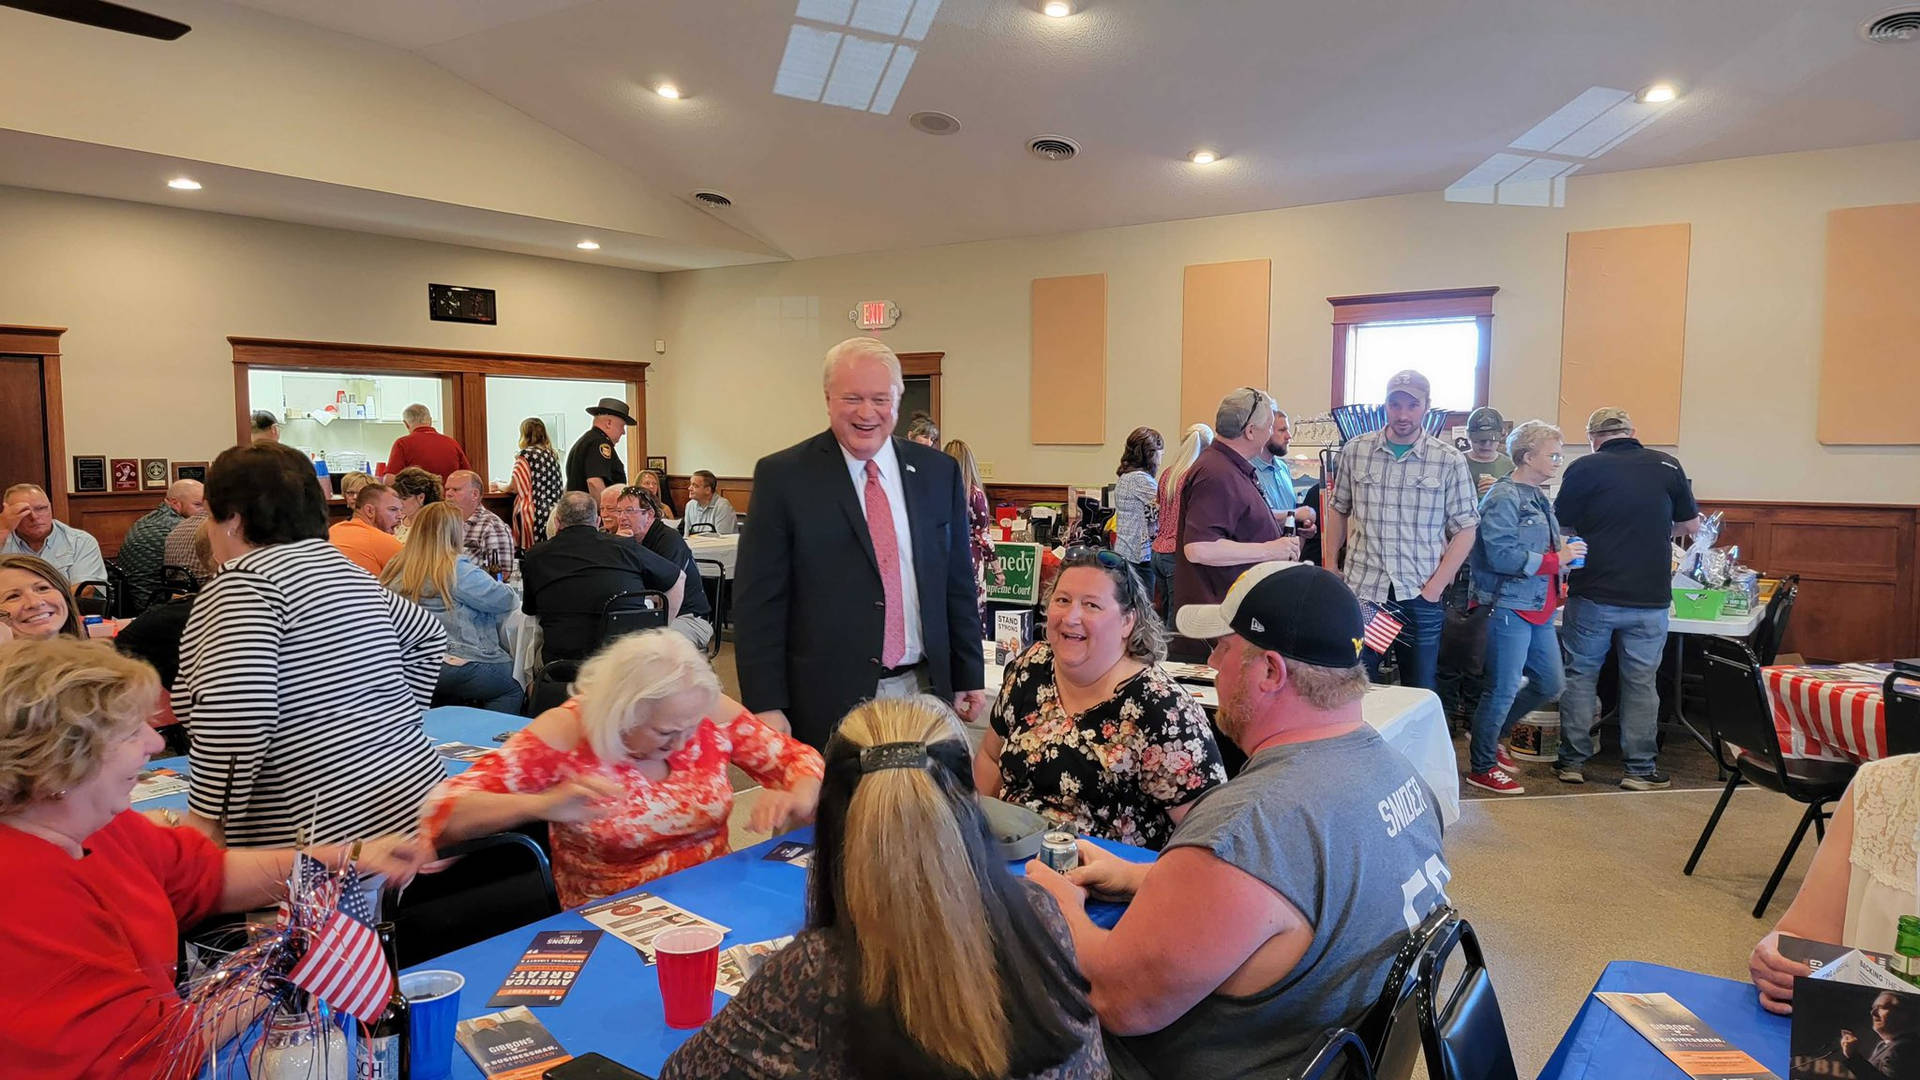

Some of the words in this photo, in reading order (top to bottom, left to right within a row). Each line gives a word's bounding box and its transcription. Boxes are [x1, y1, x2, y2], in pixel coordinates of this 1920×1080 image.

[863, 303, 885, 325] EXIT
[986, 583, 1011, 596] upreme
[1012, 583, 1031, 595] Court
[998, 616, 1019, 625] STAND
[1378, 775, 1427, 838] SNIDER
[488, 1037, 535, 1054] GIBBONS
